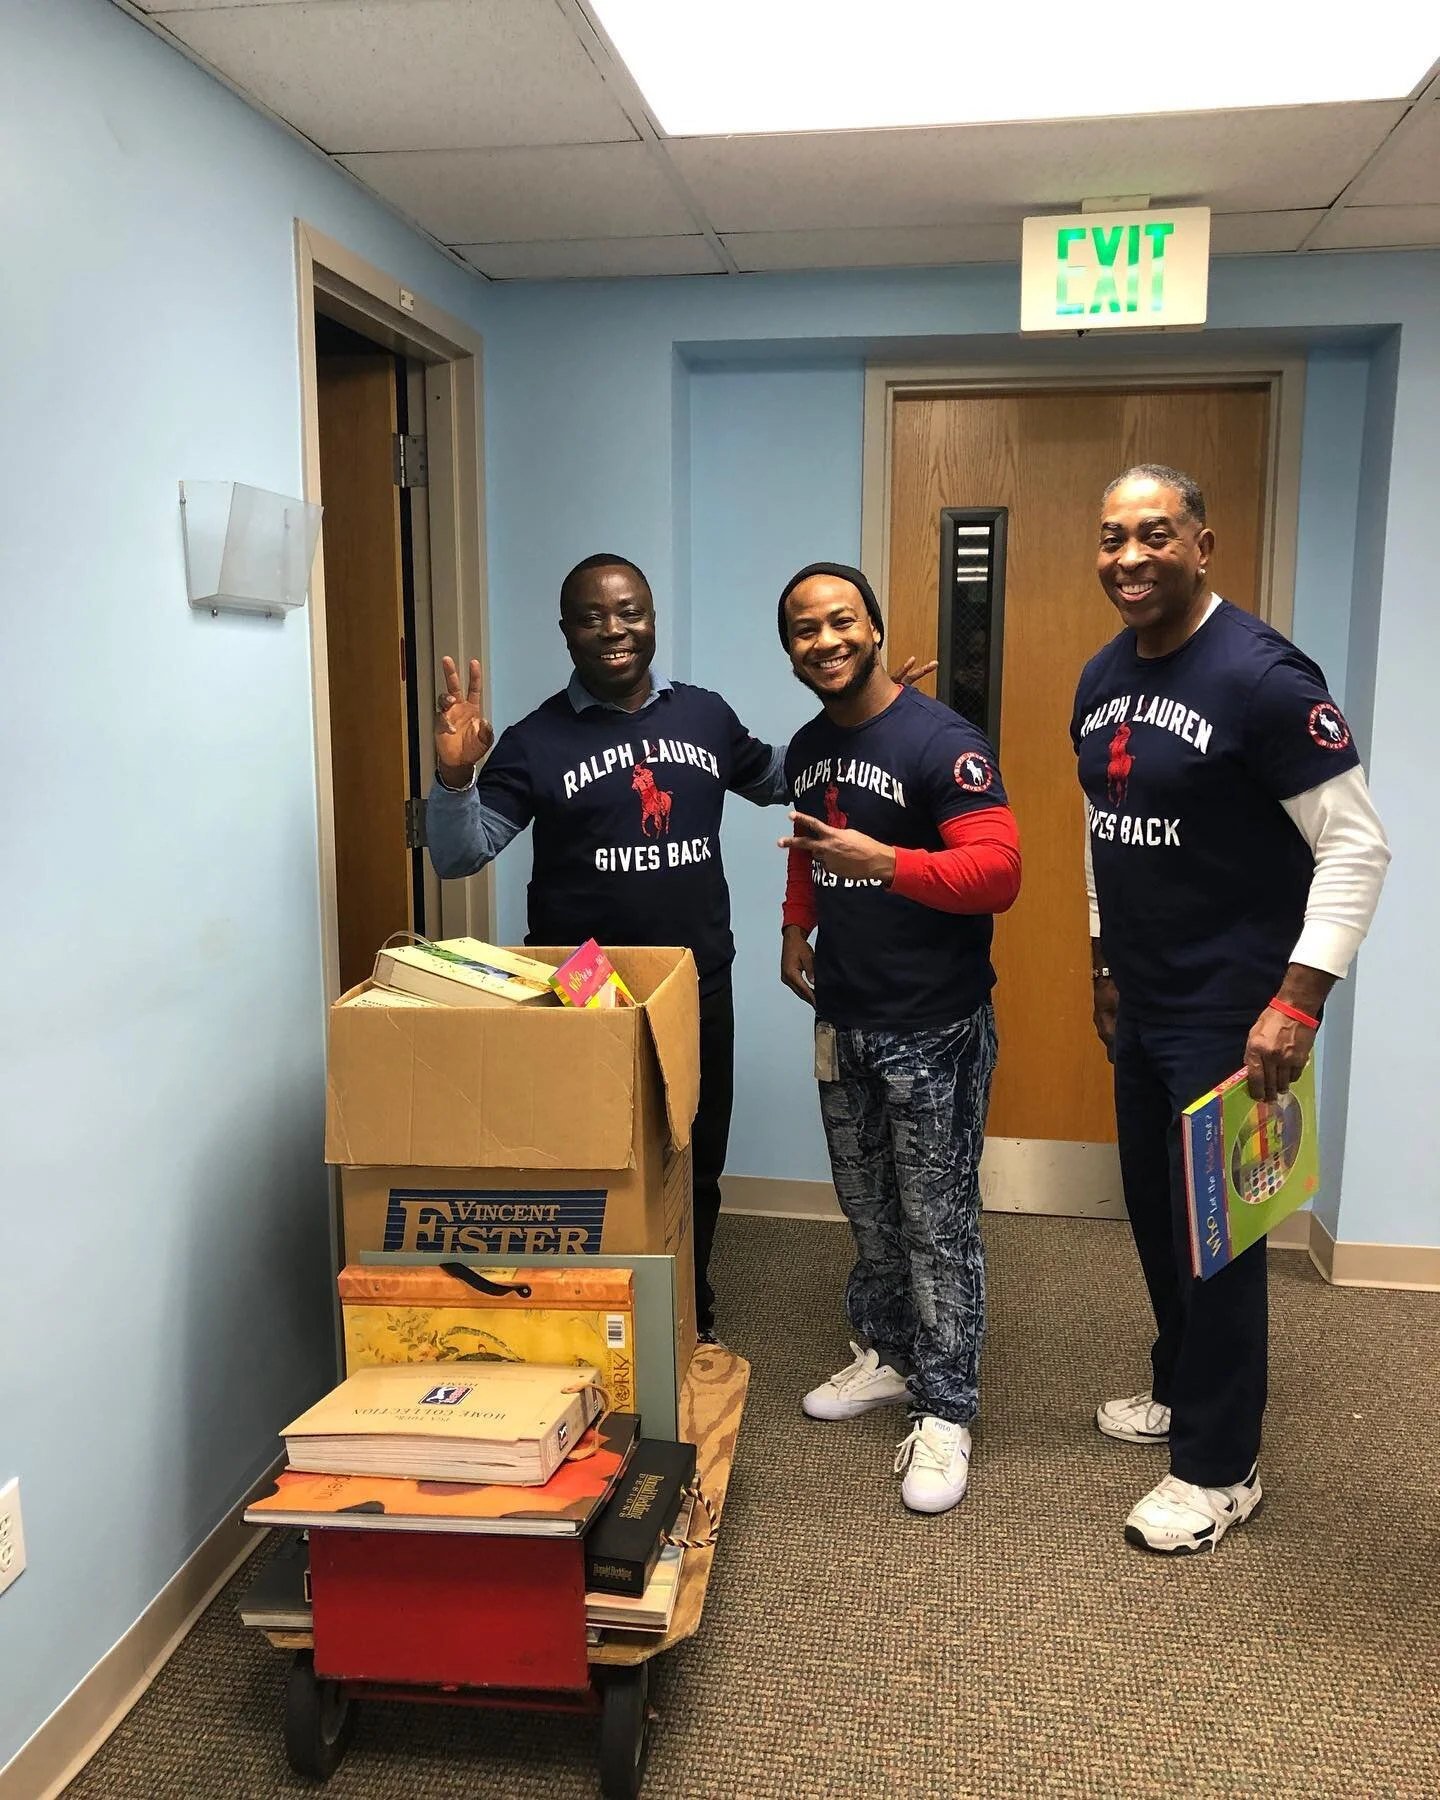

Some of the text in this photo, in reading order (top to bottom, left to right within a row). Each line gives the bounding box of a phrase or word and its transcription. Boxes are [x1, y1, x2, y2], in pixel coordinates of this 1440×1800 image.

[1056, 222, 1174, 315] EXIT
[1080, 694, 1213, 755] RALPH LAUREN
[563, 738, 720, 799] RALPH LAUREN
[794, 758, 906, 808] RALPH LAUREN
[1120, 816, 1181, 847] BACK
[595, 837, 712, 872] GIVES BACK
[1207, 1176, 1217, 1195] the
[454, 1200, 561, 1222] VINCENT
[1208, 1198, 1218, 1213] Let
[399, 1200, 590, 1255] FISTER
[1206, 1216, 1223, 1257] Who
[612, 1351, 630, 1412] YORK
[352, 1407, 506, 1421] HOME COLLECTION
[935, 1422, 950, 1432] POLO
